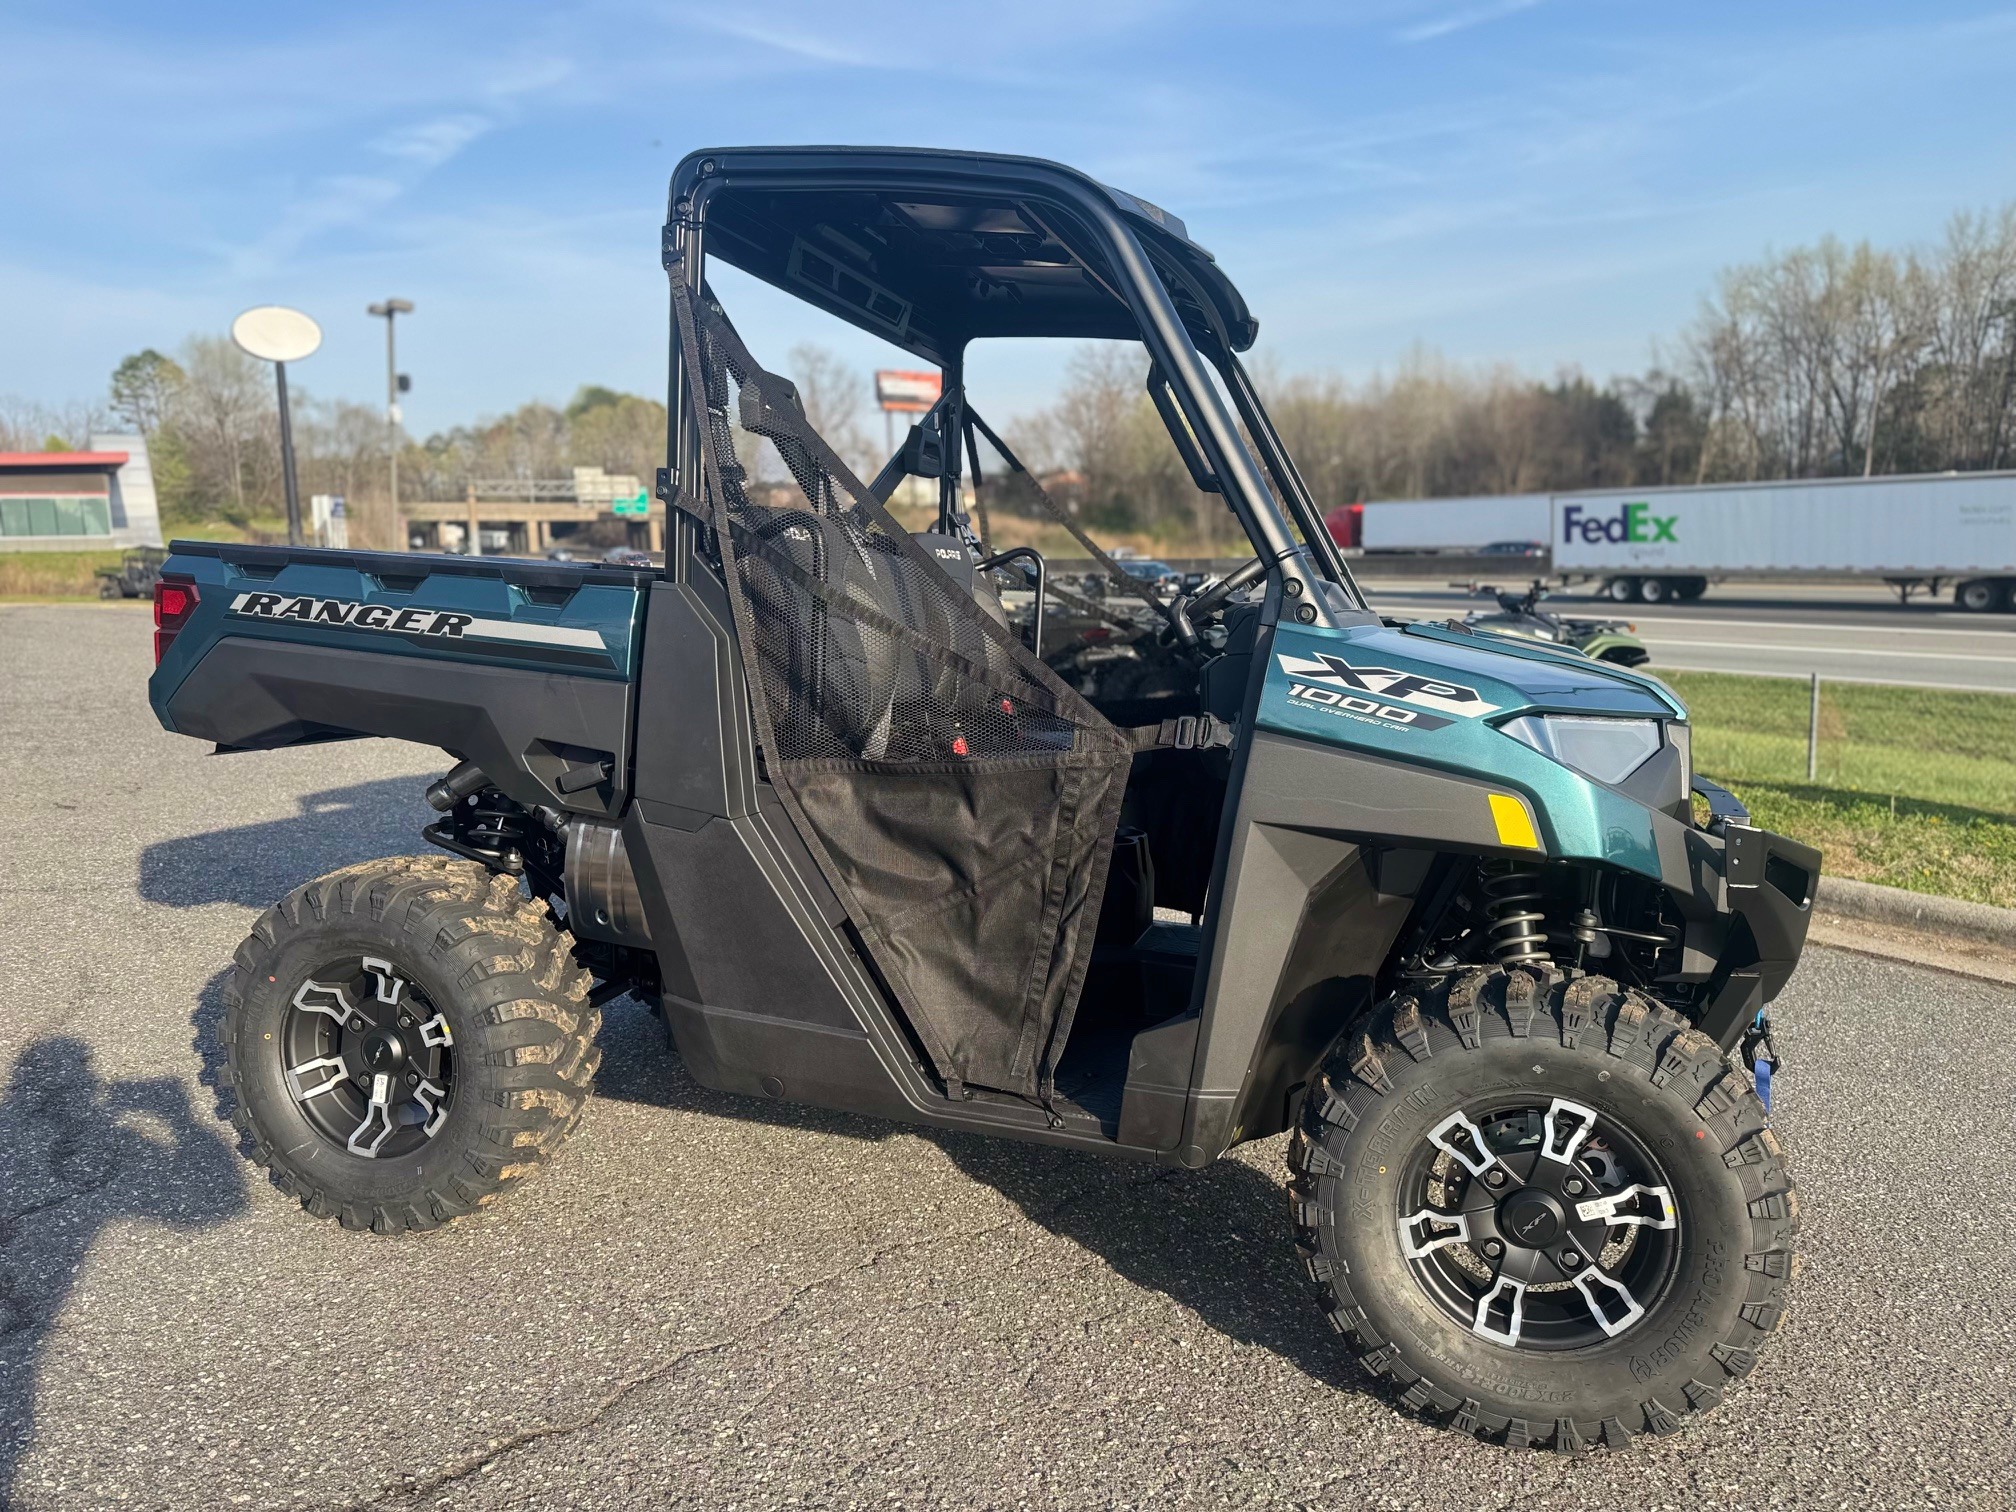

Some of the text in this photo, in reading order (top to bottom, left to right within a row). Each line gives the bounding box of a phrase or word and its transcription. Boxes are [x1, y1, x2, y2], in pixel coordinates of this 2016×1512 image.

[1564, 503, 1679, 544] FedEx
[935, 548, 961, 560] POLARIS
[239, 592, 474, 638] RANGER
[1284, 651, 1483, 702] XP
[1286, 698, 1410, 733] DUAL OVERHEAD CAM
[1287, 683, 1418, 723] 1000
[1351, 1081, 1440, 1221] X-TERRAIN
